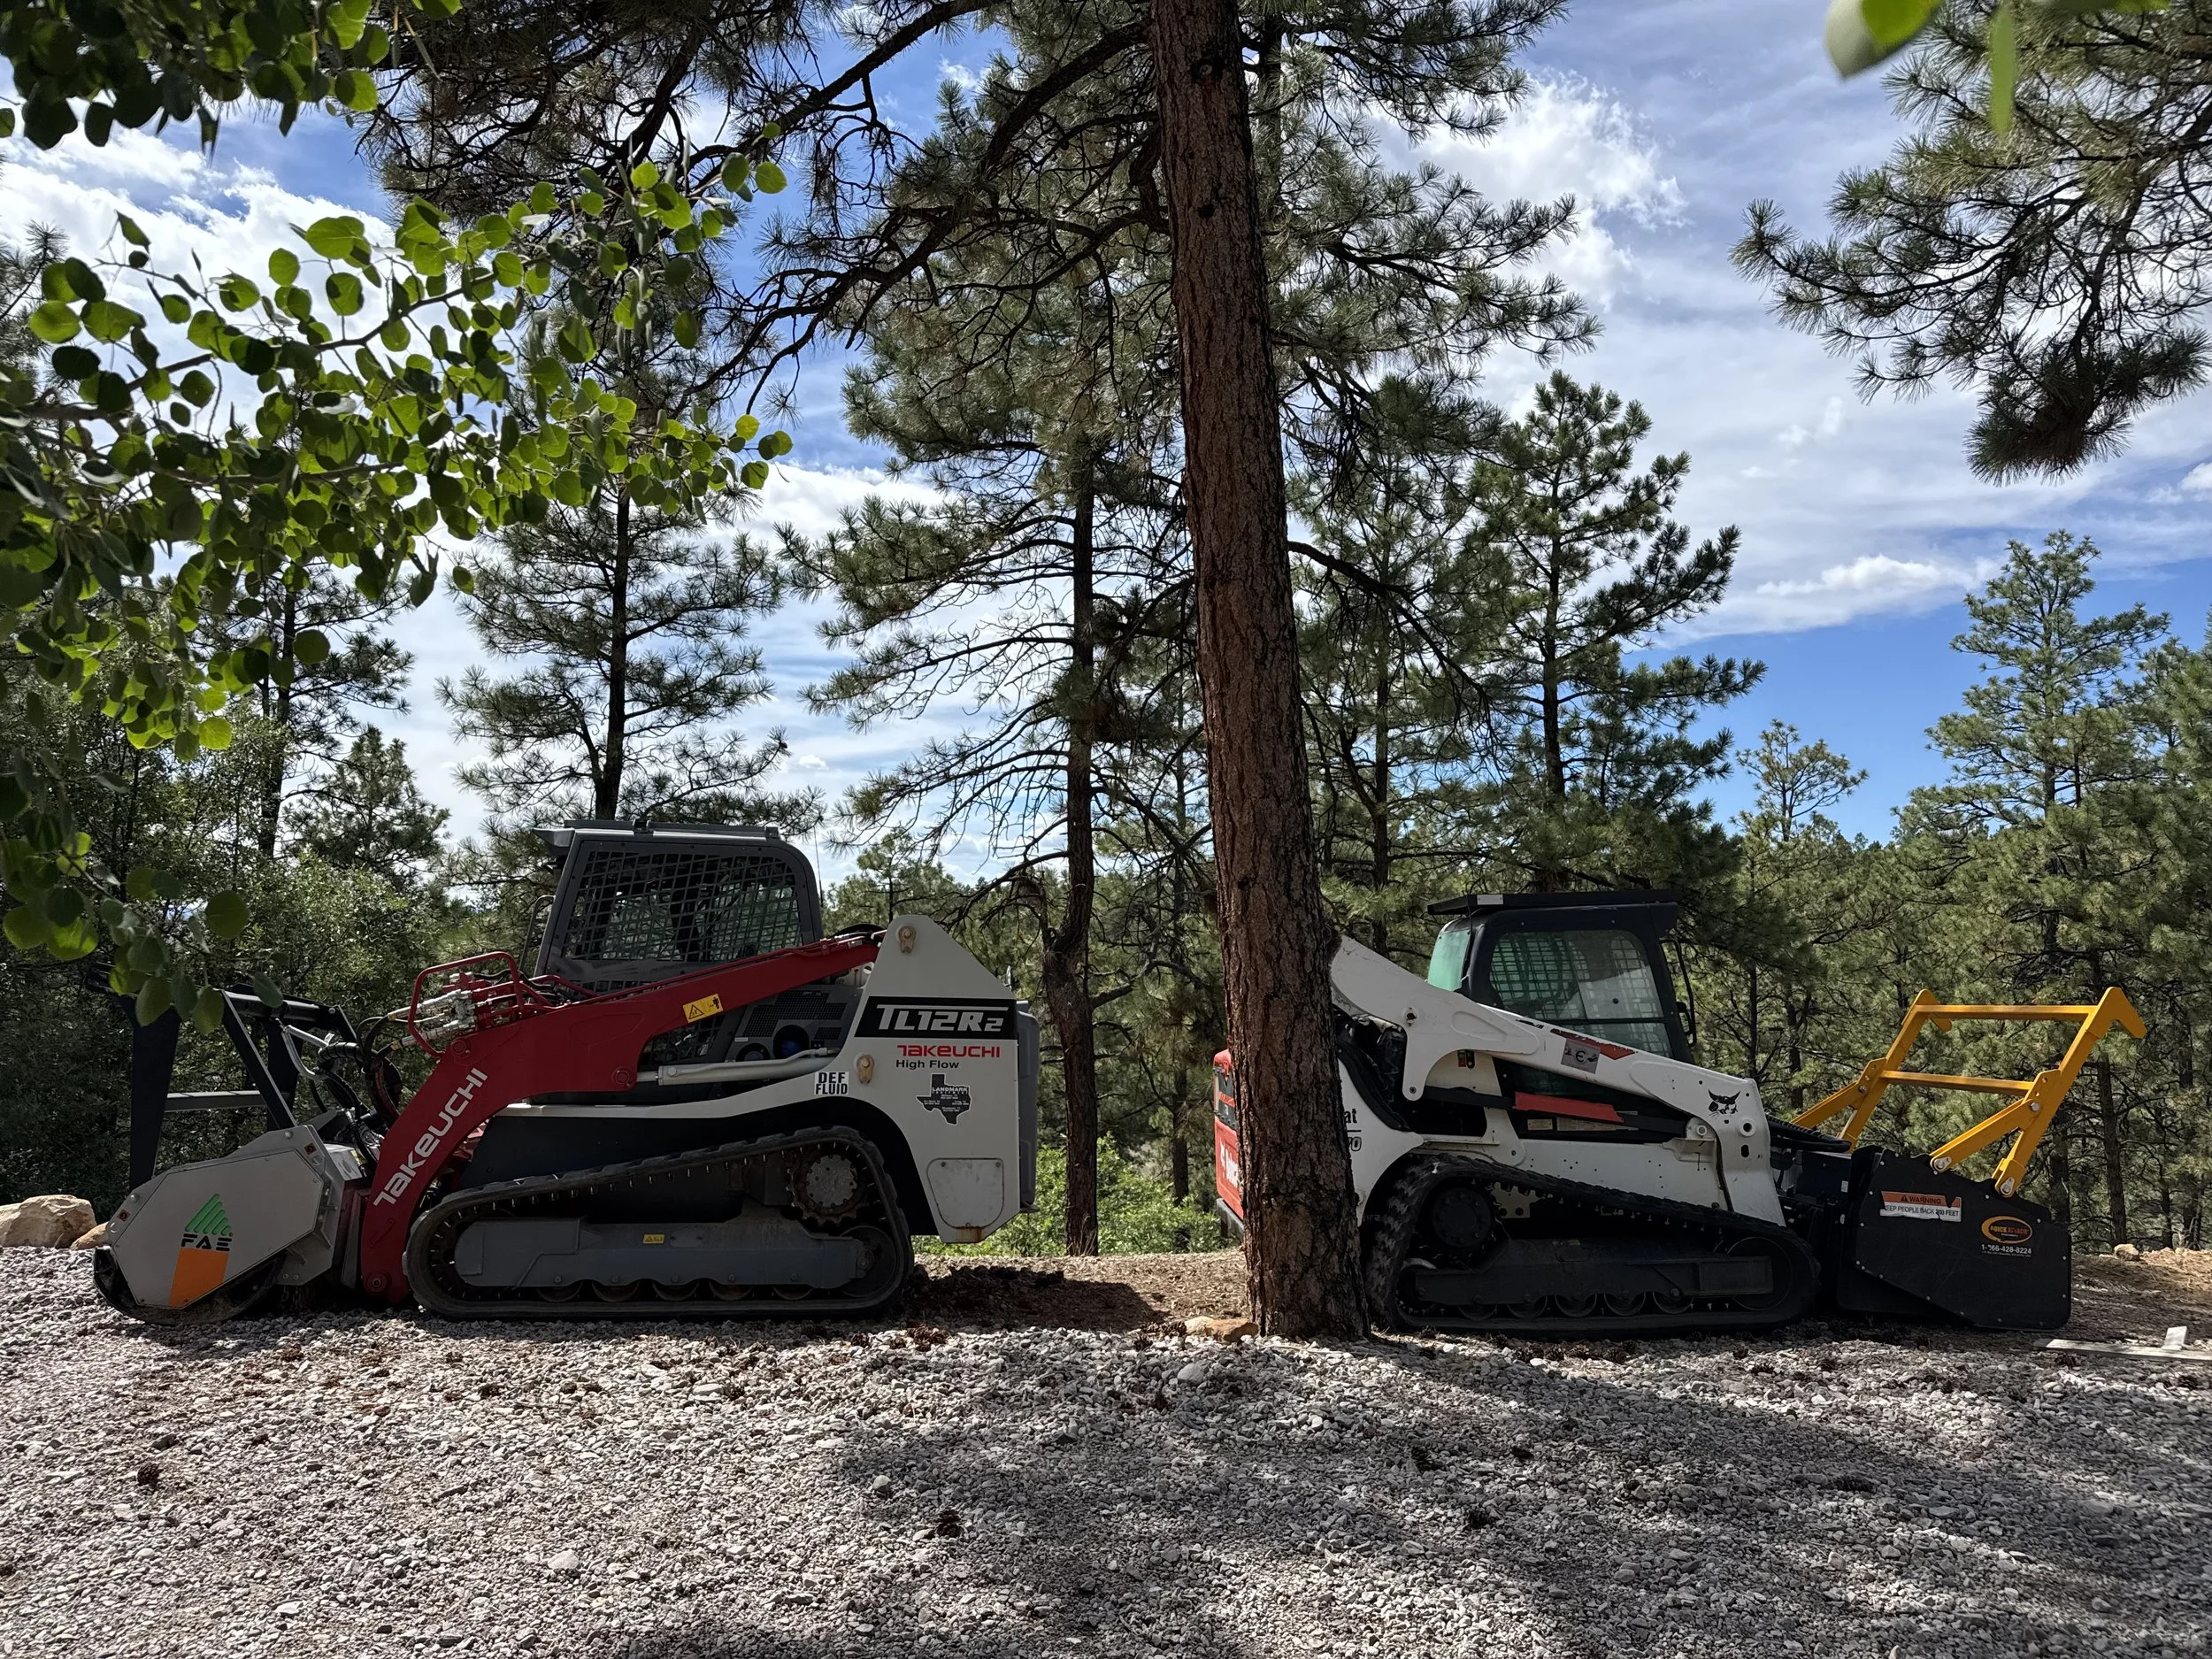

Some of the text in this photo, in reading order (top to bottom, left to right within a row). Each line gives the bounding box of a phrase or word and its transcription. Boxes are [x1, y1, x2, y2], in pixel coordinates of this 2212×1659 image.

[876, 1004, 1009, 1033] TL12R2
[895, 1059, 960, 1071] High Flow
[818, 1071, 846, 1084] DEF
[815, 1083, 848, 1095] FLUID
[1897, 1205, 1919, 1214] PEOPLE
[180, 1233, 233, 1252] FAE
